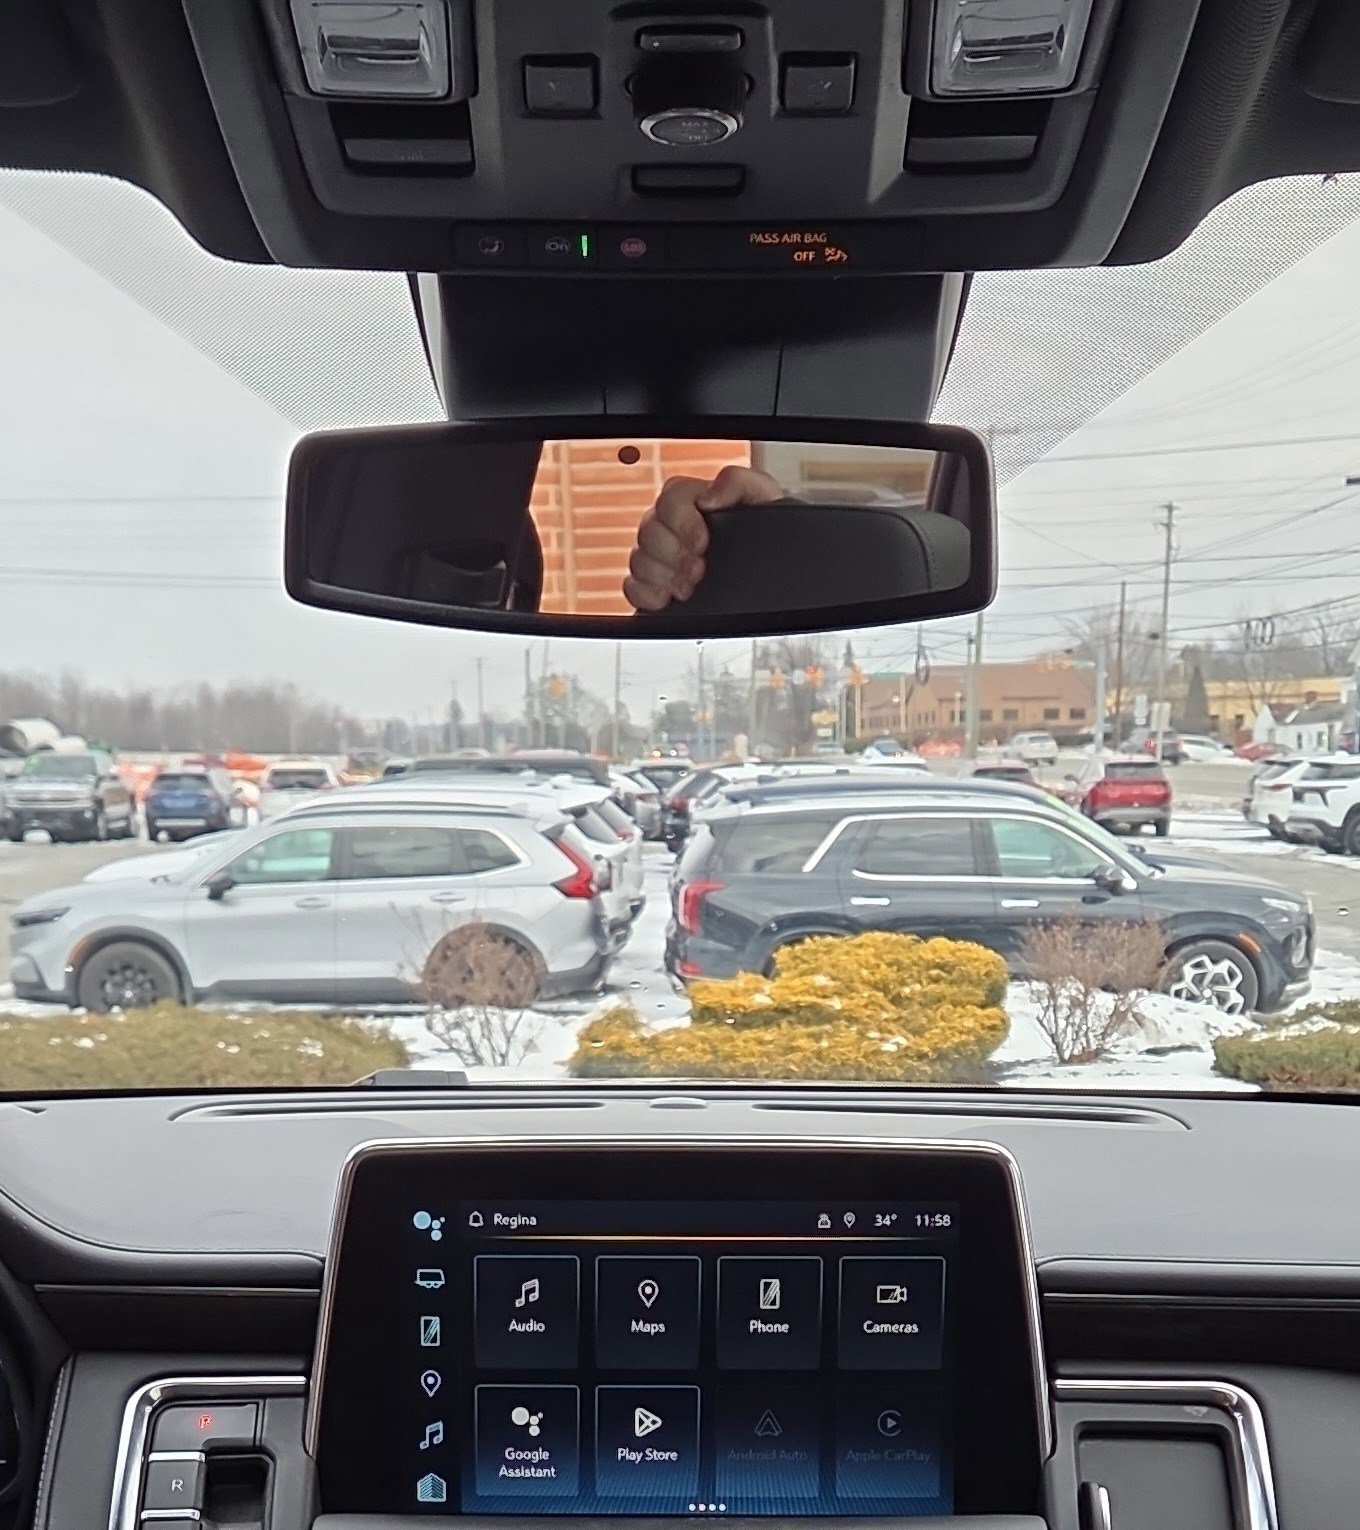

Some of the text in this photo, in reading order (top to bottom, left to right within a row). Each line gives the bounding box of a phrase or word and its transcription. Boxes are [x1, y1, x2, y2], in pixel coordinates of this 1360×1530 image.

[749, 232, 827, 243] PASS AIR BAG
[794, 251, 815, 261] OFF
[493, 1212, 537, 1229] Regina
[873, 1213, 898, 1227] 34°
[914, 1213, 952, 1227] 11:58
[508, 1318, 546, 1333] Audio
[630, 1319, 666, 1336] Maps
[749, 1319, 790, 1334] Phone
[863, 1320, 919, 1334] Cameras
[198, 1414, 213, 1430] P
[504, 1447, 550, 1463] Google
[617, 1447, 679, 1464] Play Store
[728, 1449, 808, 1461] Android Auto
[847, 1449, 931, 1464] Apple CarPlay
[498, 1465, 557, 1478] Assistant
[171, 1478, 184, 1492] R
